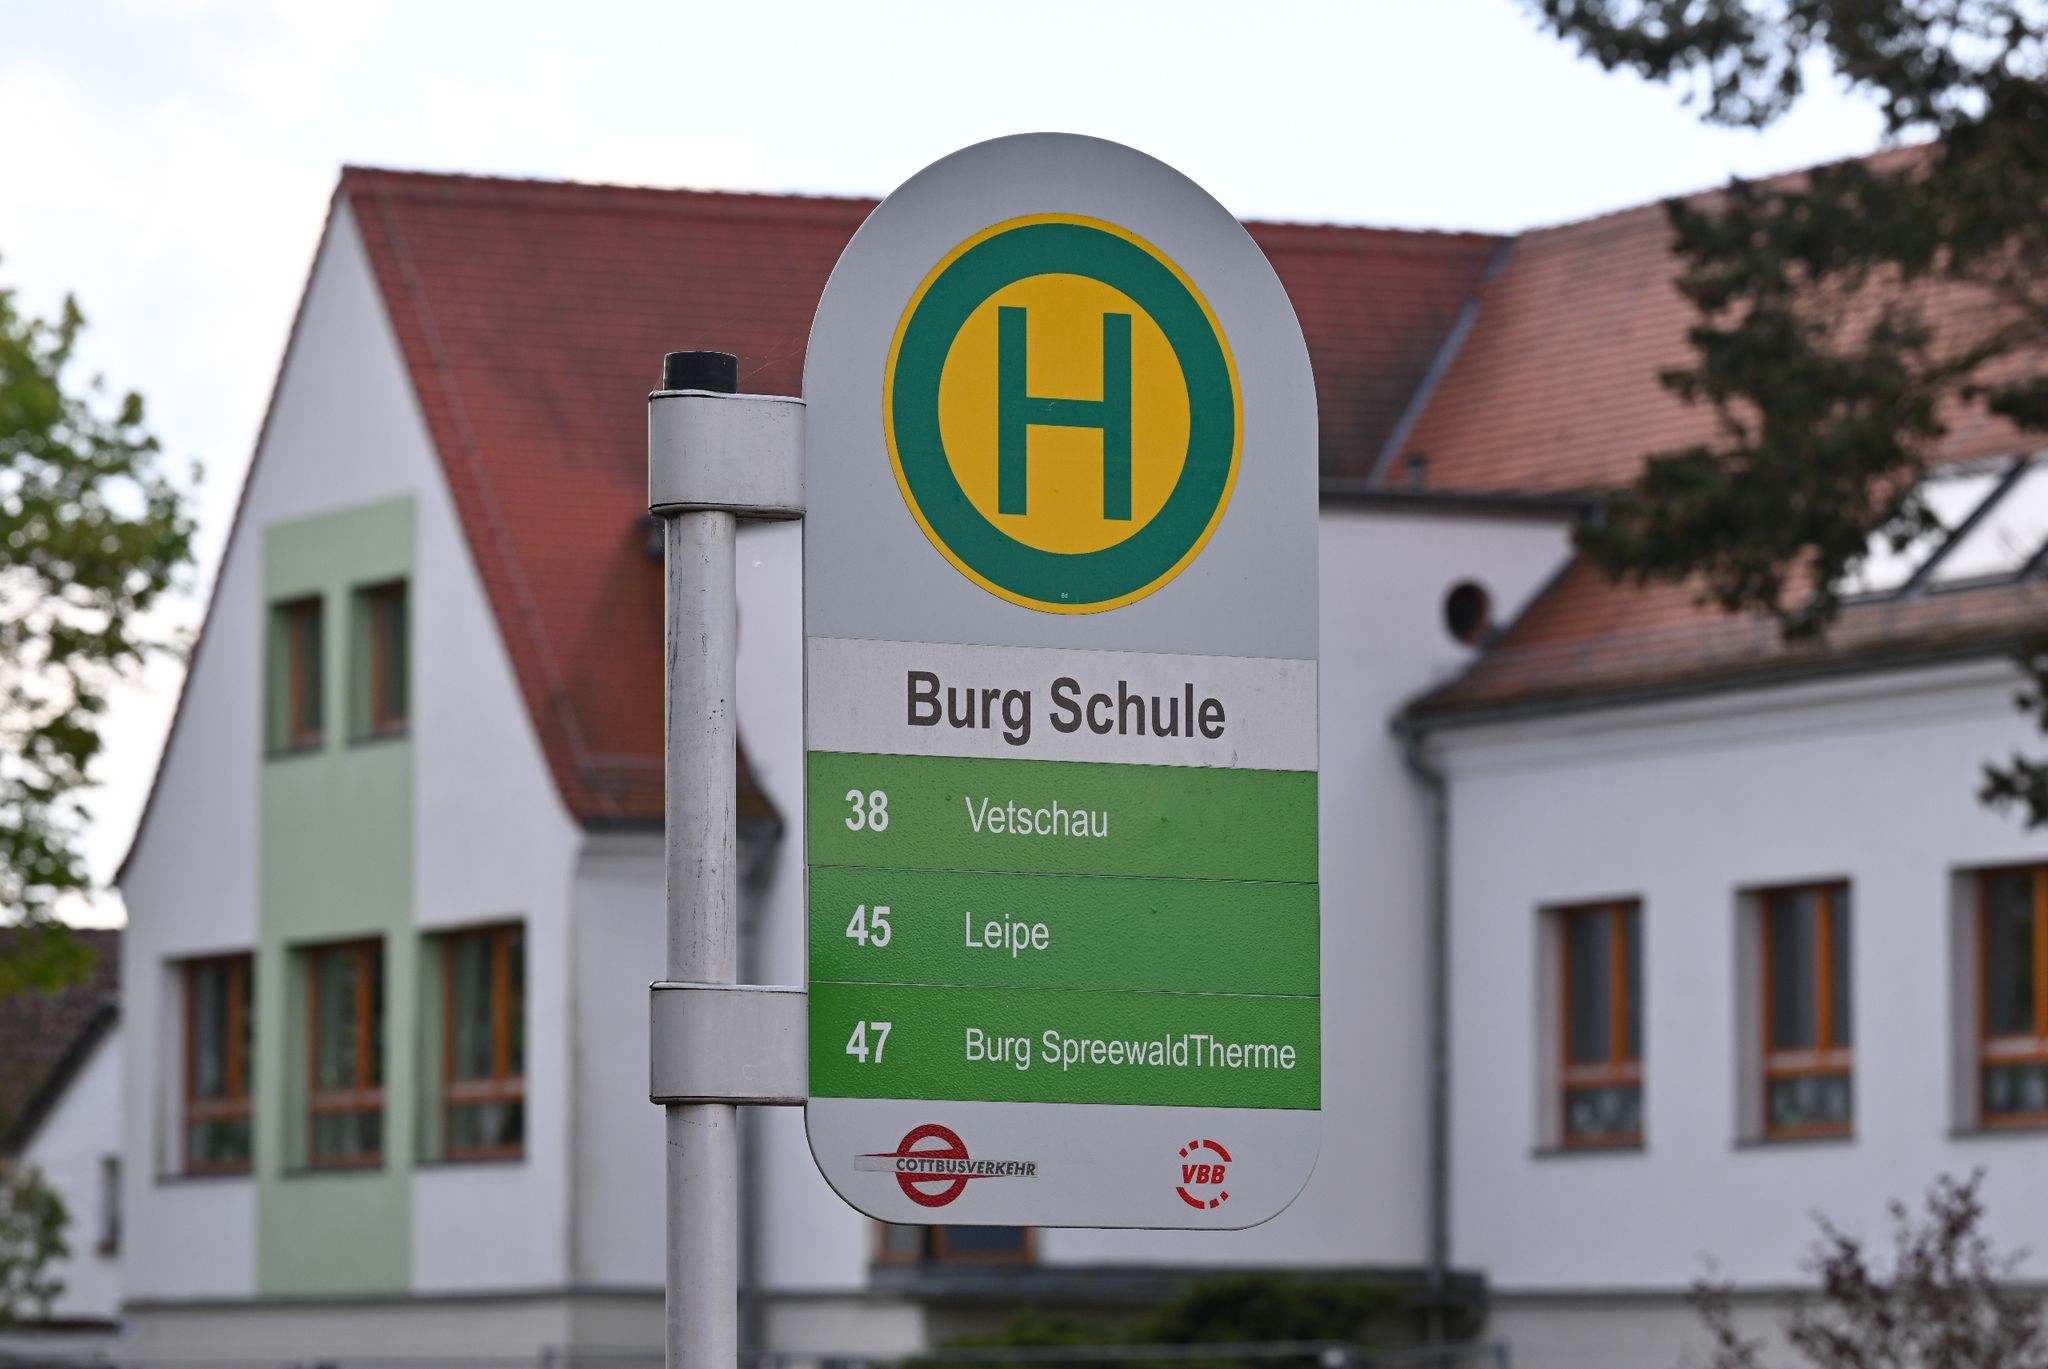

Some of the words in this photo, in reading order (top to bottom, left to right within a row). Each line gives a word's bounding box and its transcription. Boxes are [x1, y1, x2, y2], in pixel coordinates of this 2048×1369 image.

[907, 670, 1031, 746] Burg
[1049, 677, 1226, 739] Schule
[845, 789, 889, 832] 38
[965, 796, 1109, 837] Vetschau
[846, 905, 891, 947] 45
[965, 911, 1050, 958] Leipe
[846, 1020, 892, 1064] 47
[965, 1027, 1031, 1071] Burg
[1042, 1030, 1297, 1071] SpreewaldTherme
[895, 1157, 1037, 1178] COTTBUSVERKEHR
[1181, 1164, 1226, 1185] VBB
